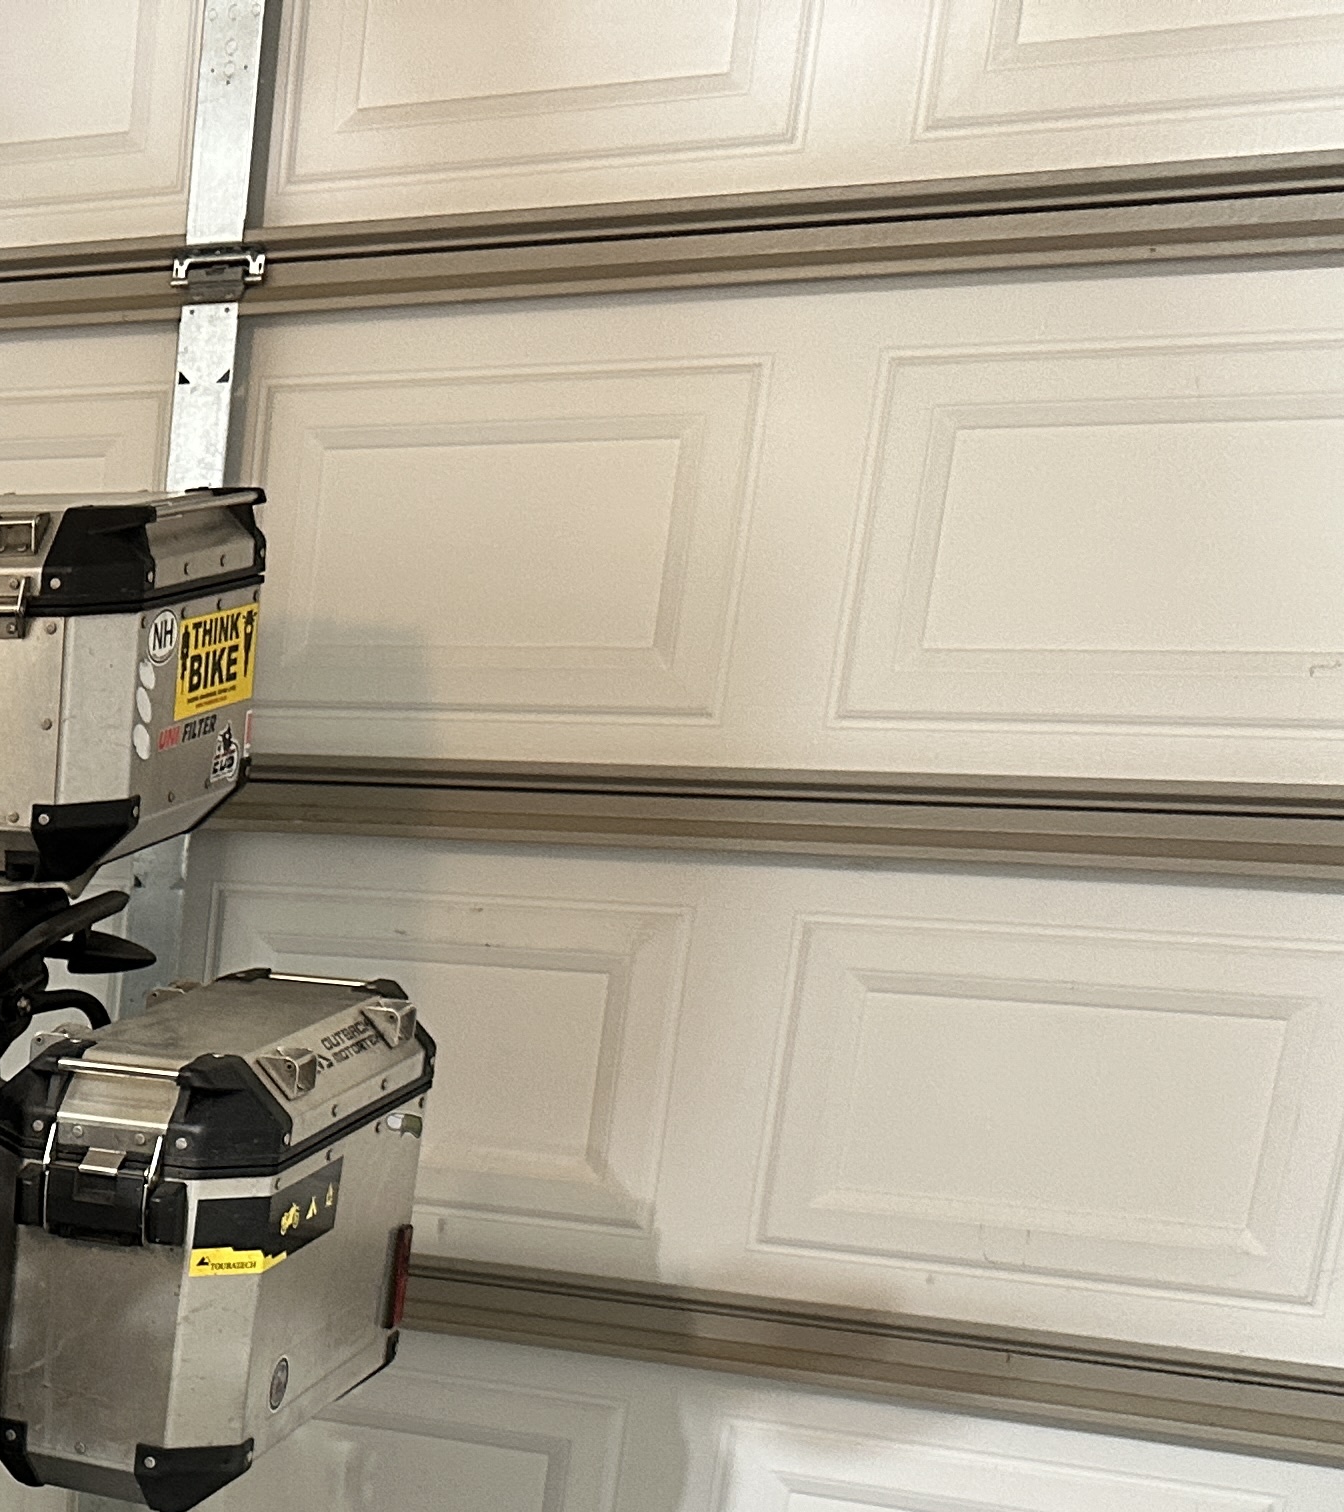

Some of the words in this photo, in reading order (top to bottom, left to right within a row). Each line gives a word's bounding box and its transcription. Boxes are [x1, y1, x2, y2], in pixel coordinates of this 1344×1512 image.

[153, 618, 174, 651] NH
[192, 612, 241, 650] THINK
[188, 644, 239, 694] BIKE
[182, 714, 217, 743] FILTER
[210, 1261, 257, 1271] TOURATECH
